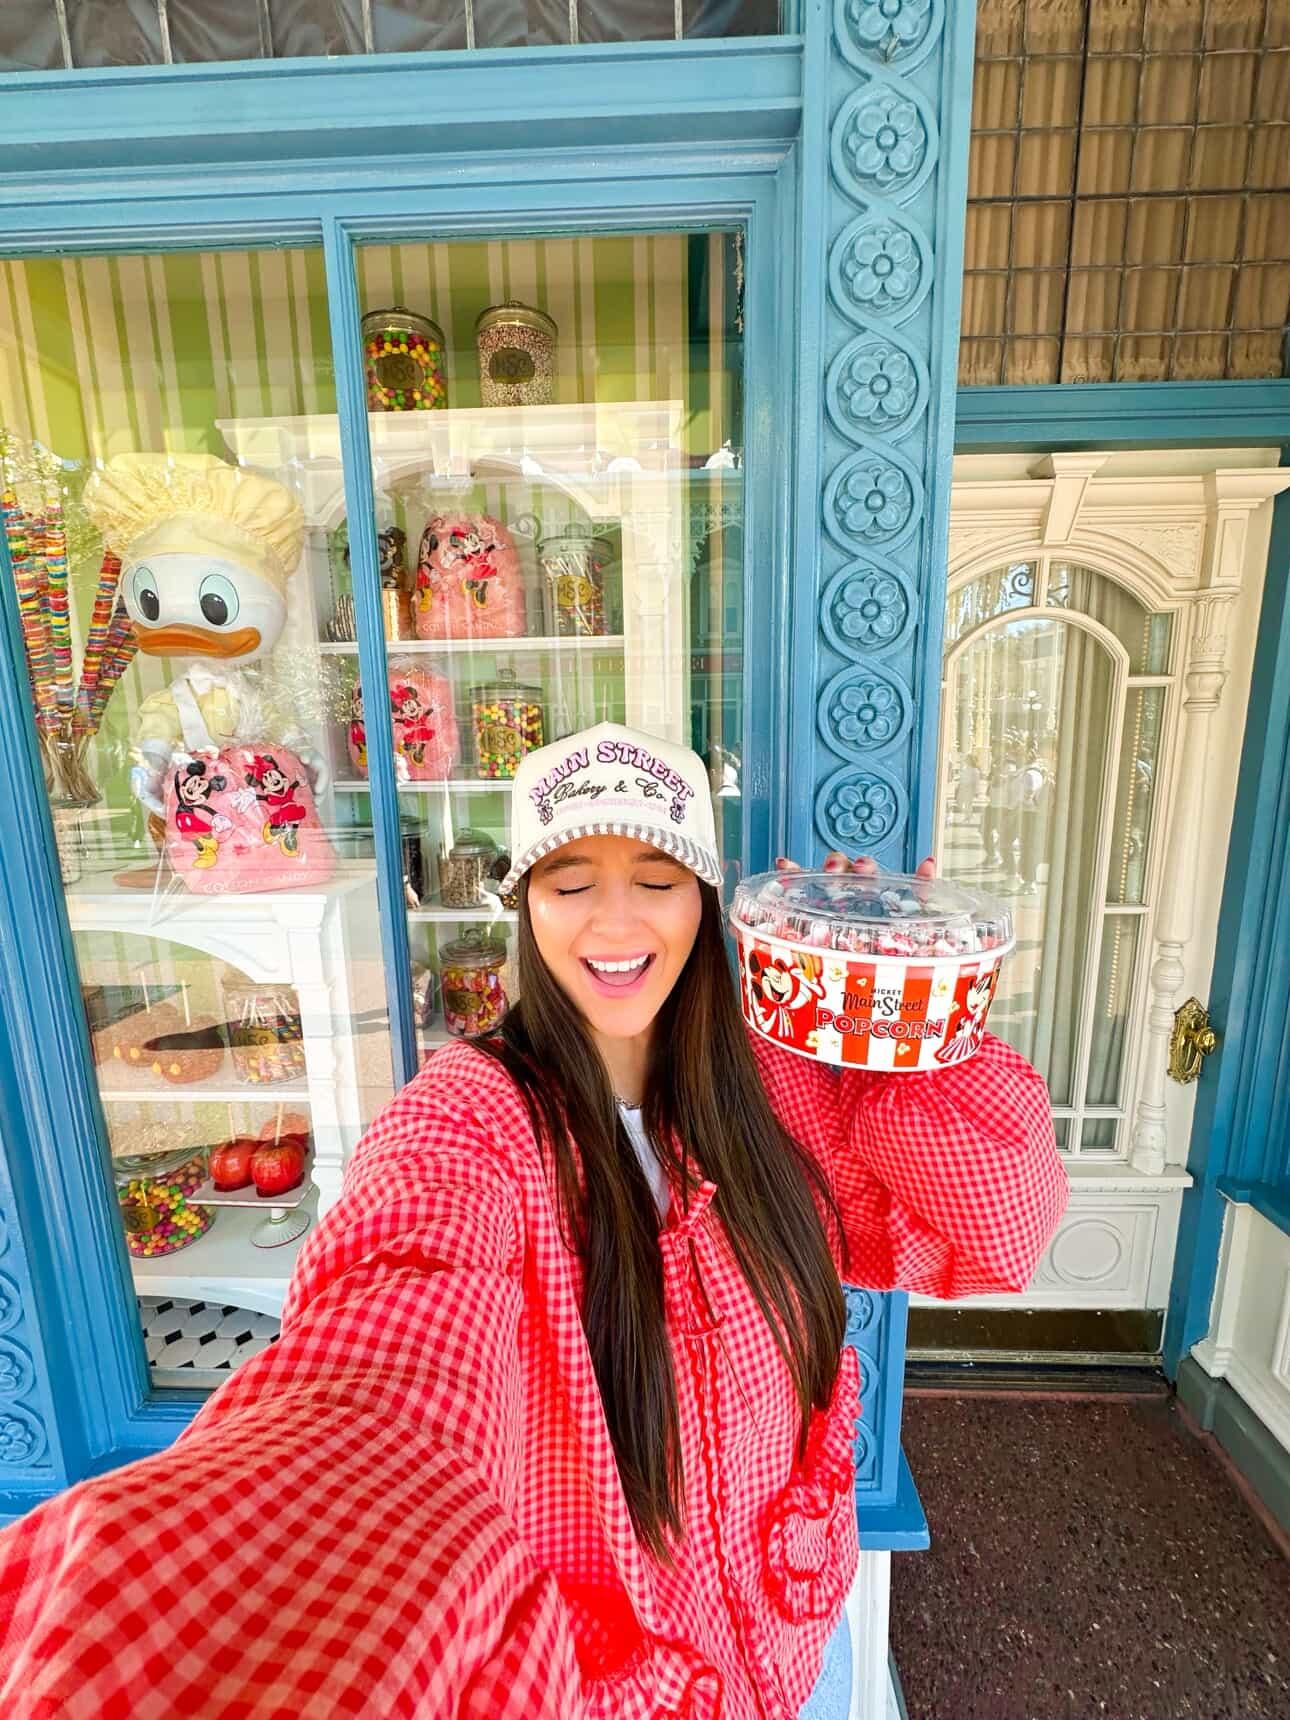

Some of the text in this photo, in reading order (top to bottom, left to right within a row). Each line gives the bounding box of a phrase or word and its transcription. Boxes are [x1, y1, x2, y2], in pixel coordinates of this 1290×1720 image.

[529, 741, 694, 806] MAIN STREET
[554, 779, 607, 804] Bakery
[615, 780, 628, 793] &
[815, 1007, 945, 1040] POPCORN
